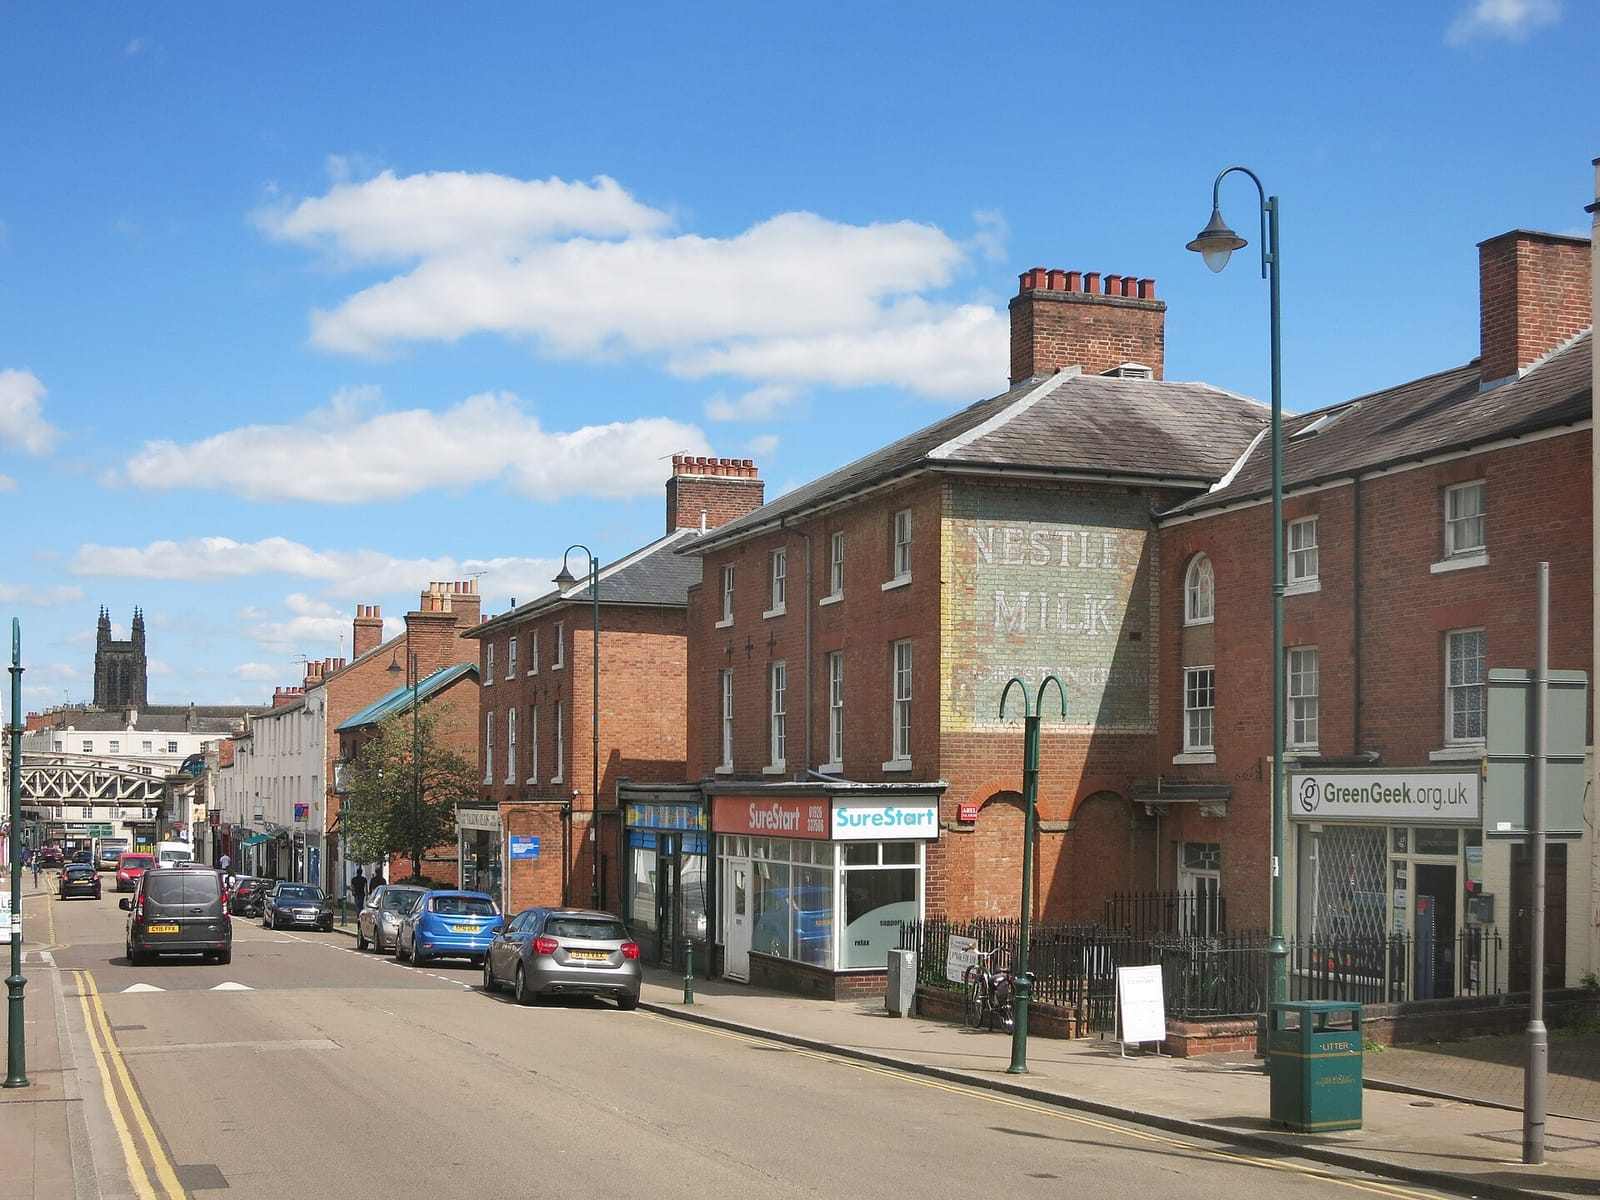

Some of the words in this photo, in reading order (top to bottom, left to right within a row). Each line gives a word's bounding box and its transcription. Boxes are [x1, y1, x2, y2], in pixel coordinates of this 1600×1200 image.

[993, 590, 1119, 635] MILK
[1323, 782, 1468, 811] GreenGeek.org.uk
[748, 802, 801, 831] SureStart
[836, 806, 935, 827] SureStart
[854, 938, 870, 947] relax
[1322, 1041, 1349, 1051] LITTER
